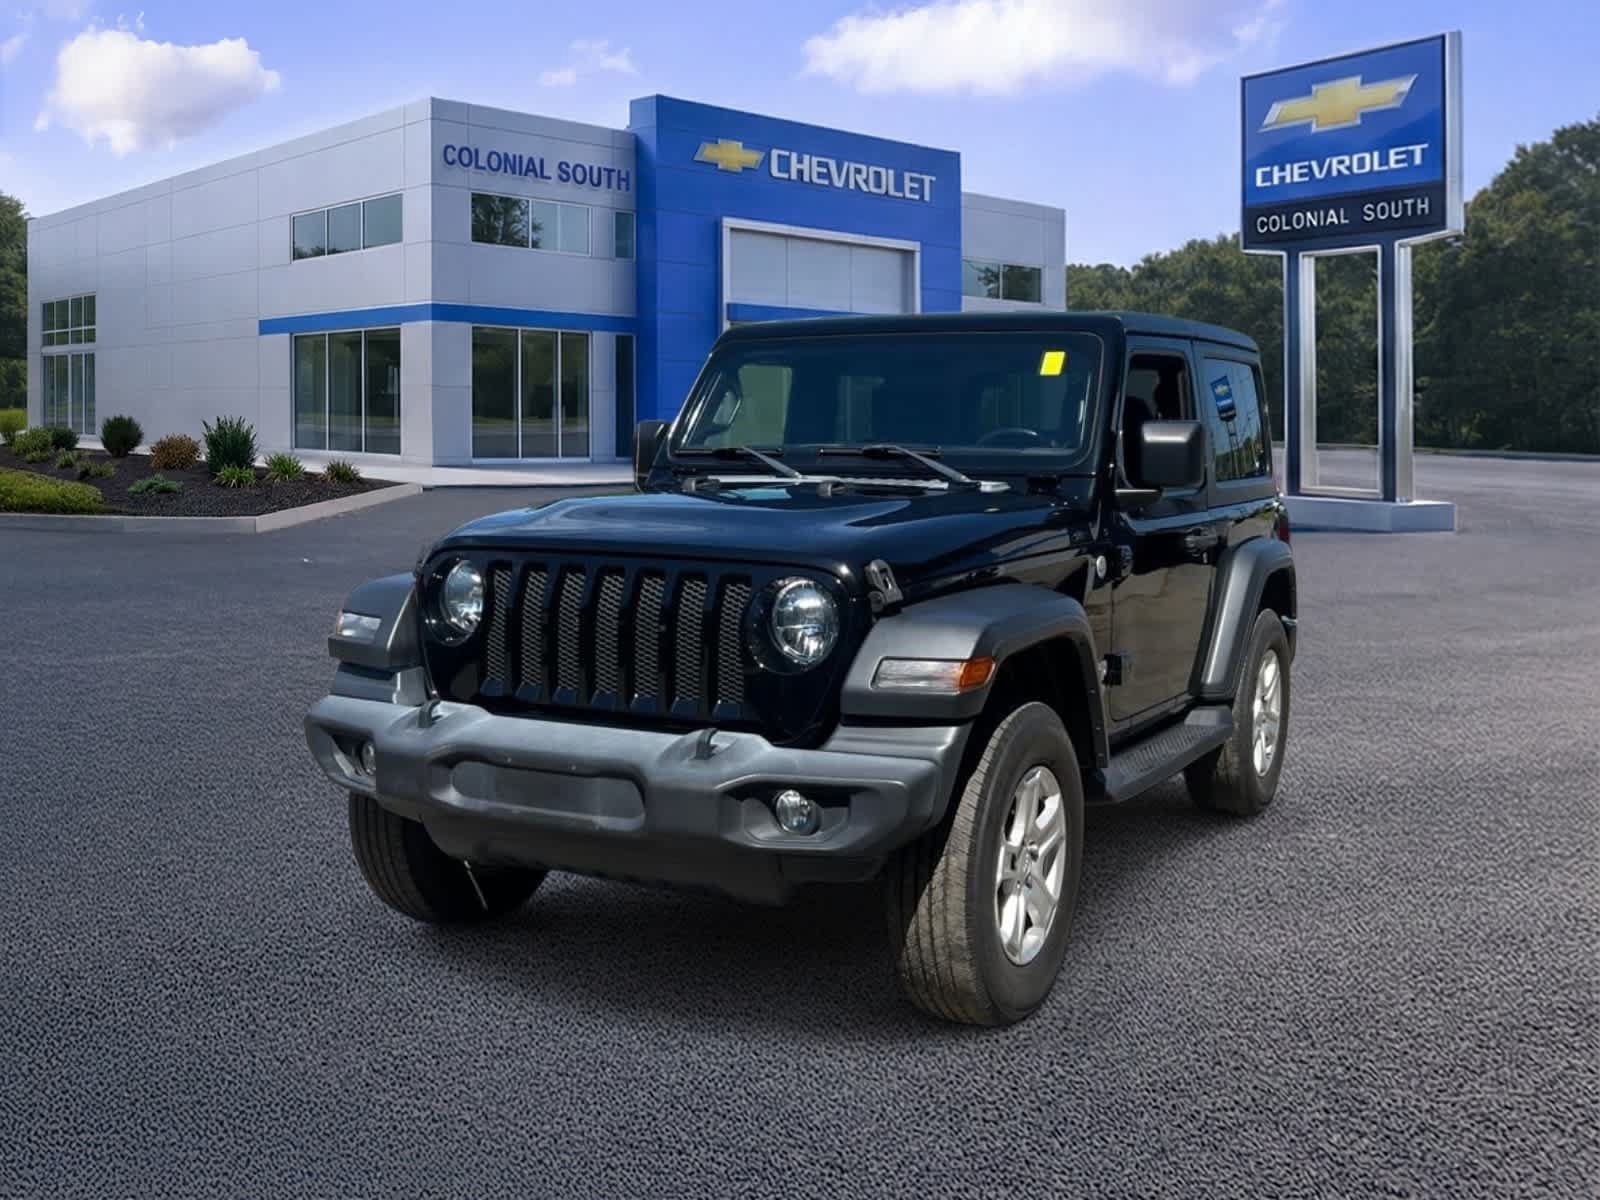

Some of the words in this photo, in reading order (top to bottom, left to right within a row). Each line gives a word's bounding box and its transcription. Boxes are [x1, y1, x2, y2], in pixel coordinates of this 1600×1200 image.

[443, 144, 552, 180] COLONIAL
[557, 161, 630, 192] SOUTH
[770, 149, 936, 202] CHEVROLET
[1255, 143, 1429, 187] CHEVROLET
[1256, 207, 1349, 233] COLONIAL
[1362, 198, 1429, 222] SOUTH
